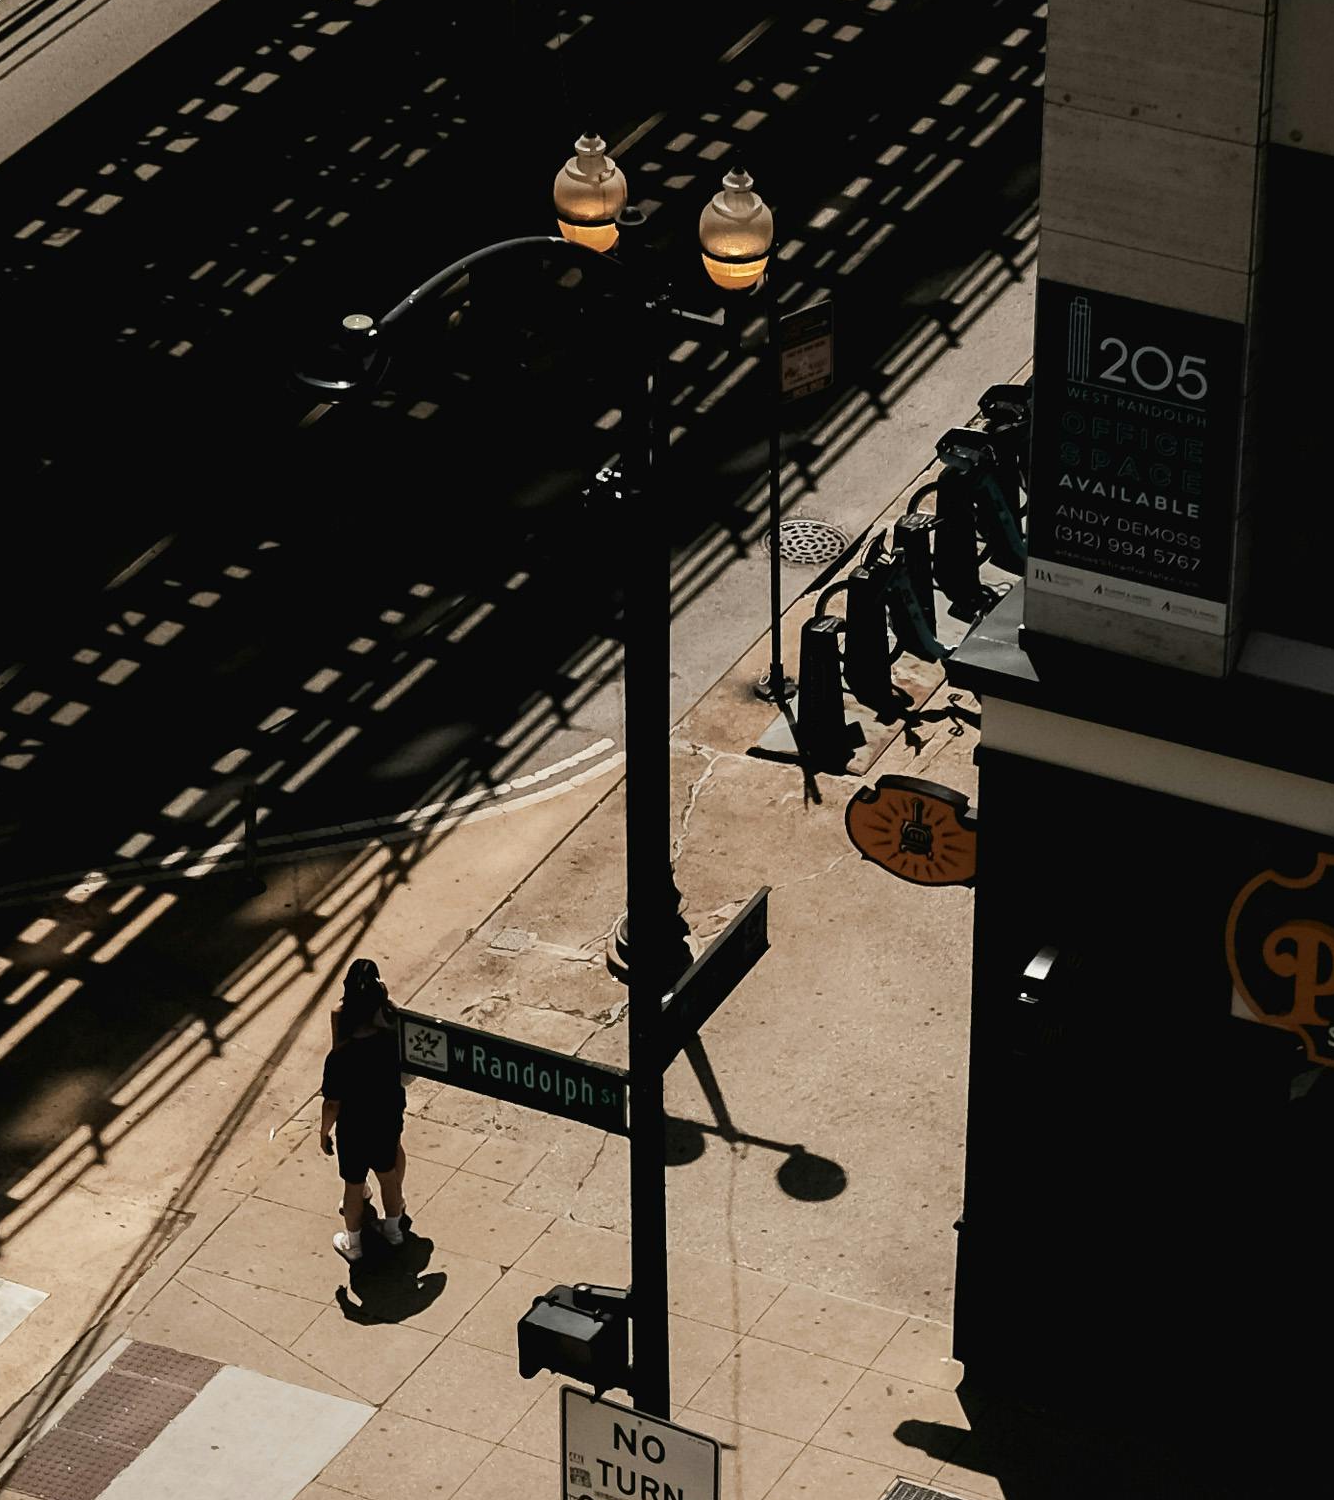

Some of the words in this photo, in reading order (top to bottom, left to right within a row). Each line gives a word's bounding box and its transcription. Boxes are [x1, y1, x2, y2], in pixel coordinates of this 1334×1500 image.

[1099, 336, 1208, 401] 205
[1067, 387, 1109, 405] WEST
[1115, 394, 1208, 429] RANDOLPH
[1061, 411, 1204, 463] OFFICE
[1060, 442, 1203, 495] SPACE
[1058, 473, 1201, 520] AVAILABLE
[1054, 524, 1101, 550] (312)
[1108, 537, 1147, 559] 994
[1153, 549, 1203, 572] 5767
[1055, 504, 1110, 527] ANDY
[1117, 517, 1202, 550] DEMOSS
[472, 1044, 595, 1107] Randolph
[599, 1087, 619, 1108] St
[613, 1422, 666, 1465] NO
